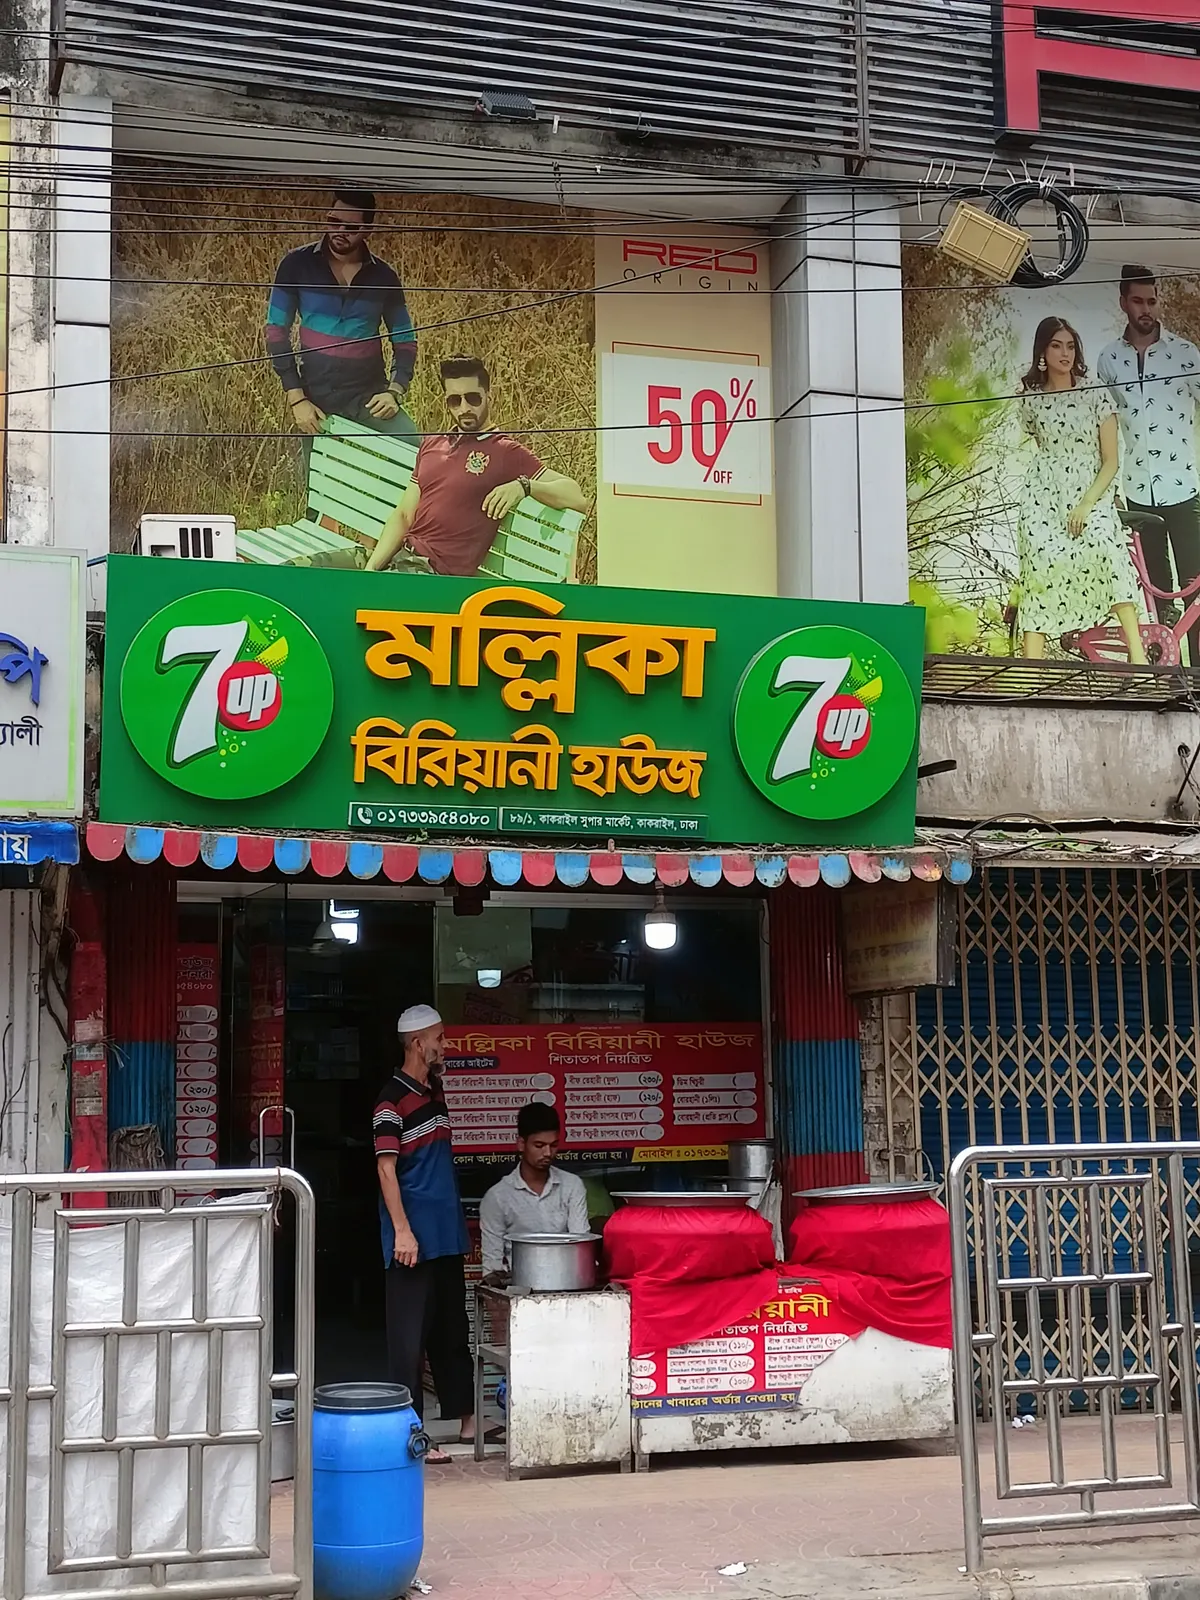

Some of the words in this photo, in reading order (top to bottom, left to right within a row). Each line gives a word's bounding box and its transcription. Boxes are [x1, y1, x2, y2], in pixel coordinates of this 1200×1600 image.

[623, 239, 758, 275] RED
[623, 268, 758, 292] ORIGIN
[647, 377, 757, 483] 50%
[713, 470, 733, 484] OFF
[356, 586, 717, 714] মল্লিকা
[351, 717, 564, 795] বিরিয়ানী
[568, 733, 708, 799] হাউজ
[377, 809, 491, 825] ০১৭৩৩৯৫৪০৮০
[538, 813, 579, 826] কাকরাইল
[580, 815, 603, 829] সুপার
[605, 813, 634, 830] মার্কেট,
[636, 816, 678, 831] কাকরাইল,
[679, 818, 699, 831] ঢাকা
[442, 1032, 536, 1054] মল্লিকা
[544, 1030, 665, 1051] বিরিয়ানী
[674, 1030, 755, 1050] হাউজ
[548, 1052, 601, 1066] শিতাতপ
